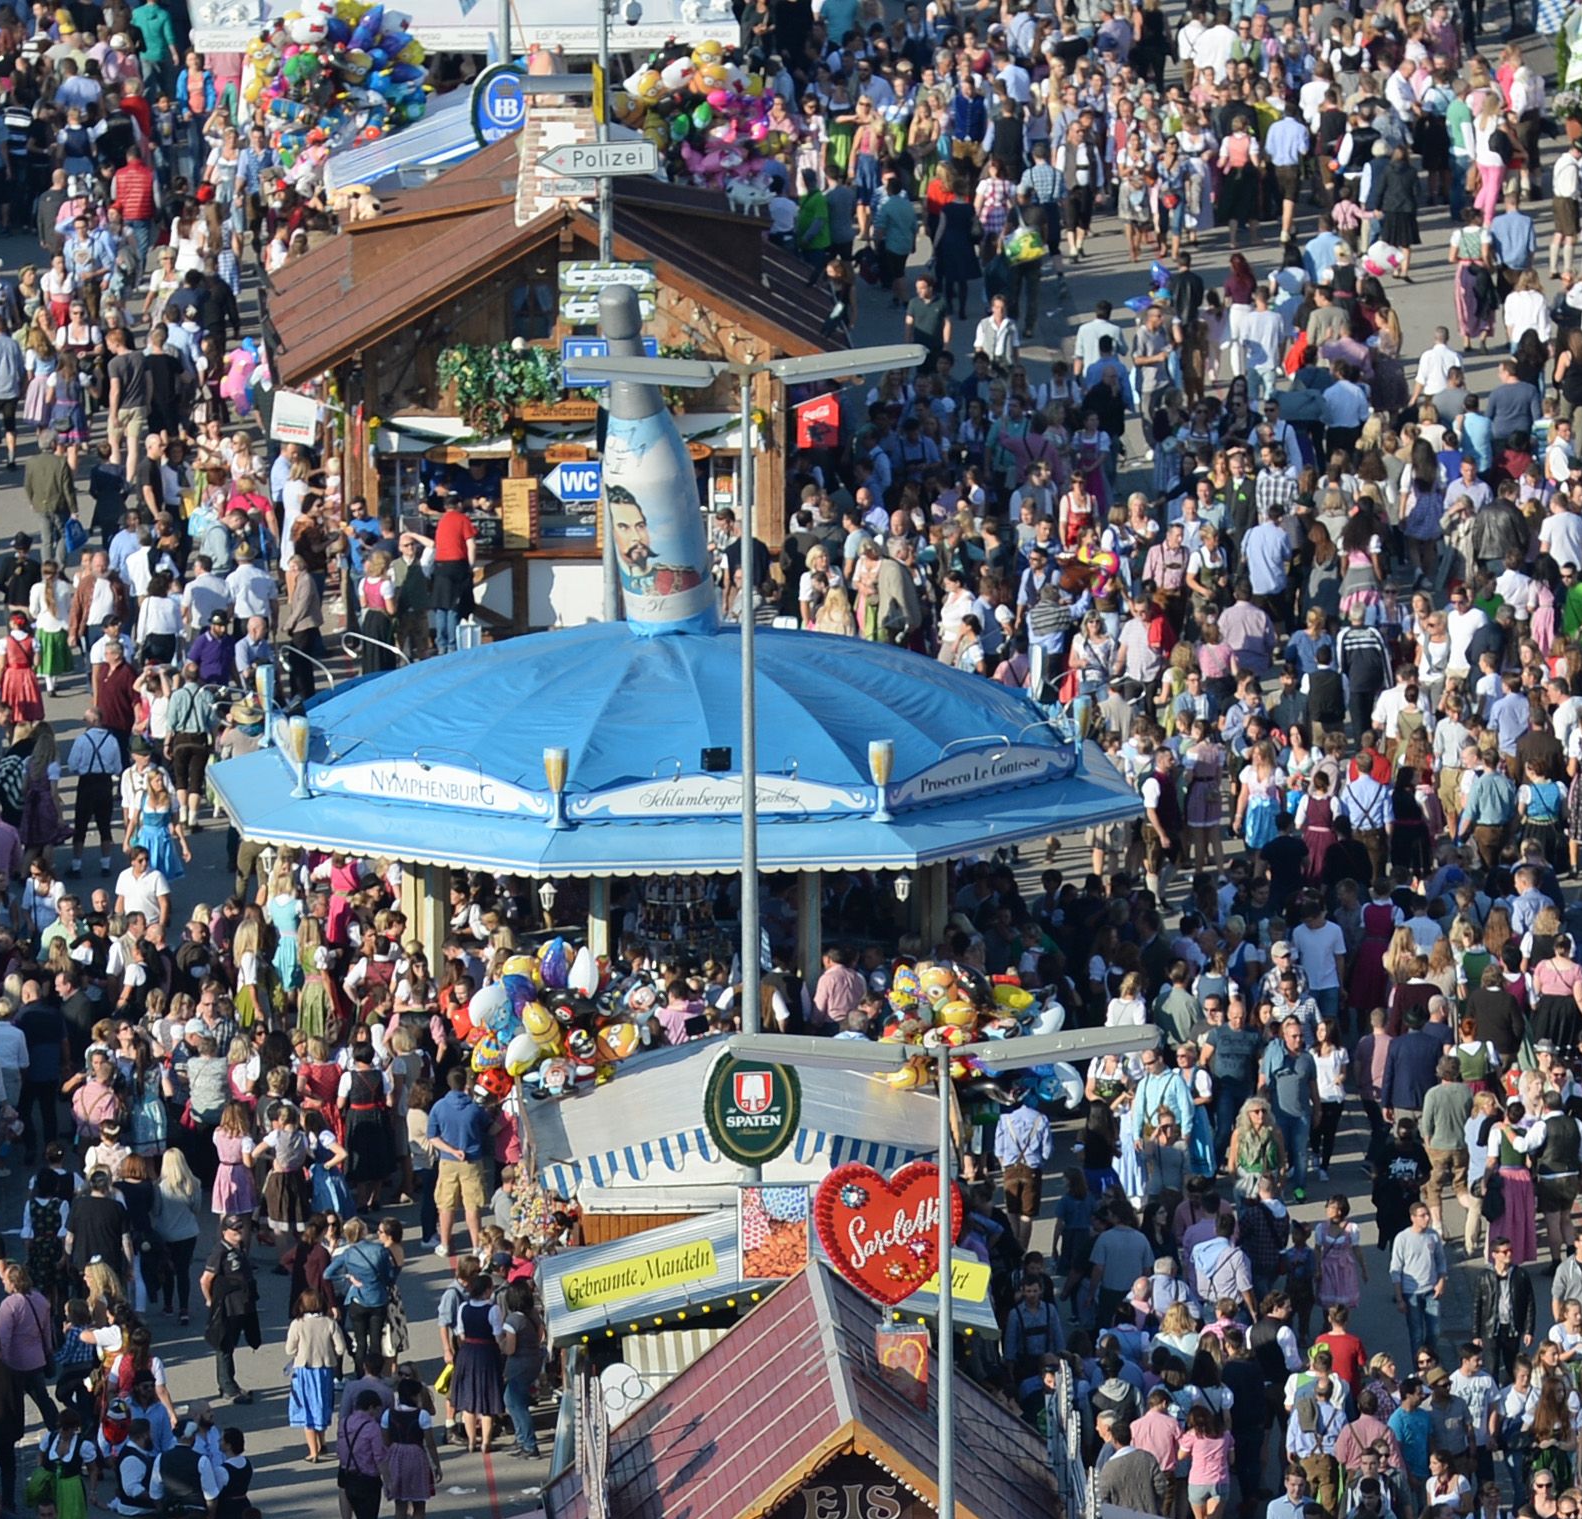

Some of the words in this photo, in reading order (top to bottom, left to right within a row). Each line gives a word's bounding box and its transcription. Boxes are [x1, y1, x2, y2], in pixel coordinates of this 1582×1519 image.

[494, 98, 519, 117] HB
[573, 146, 645, 168] Polizei
[562, 471, 598, 492] WC
[920, 774, 971, 793] Prosecco
[974, 766, 989, 781] Le
[991, 757, 1040, 778] Contesse
[726, 1115, 781, 1127] SPATEN
[567, 1267, 640, 1306] Gebrannte
[641, 1247, 712, 1286] Mandeln
